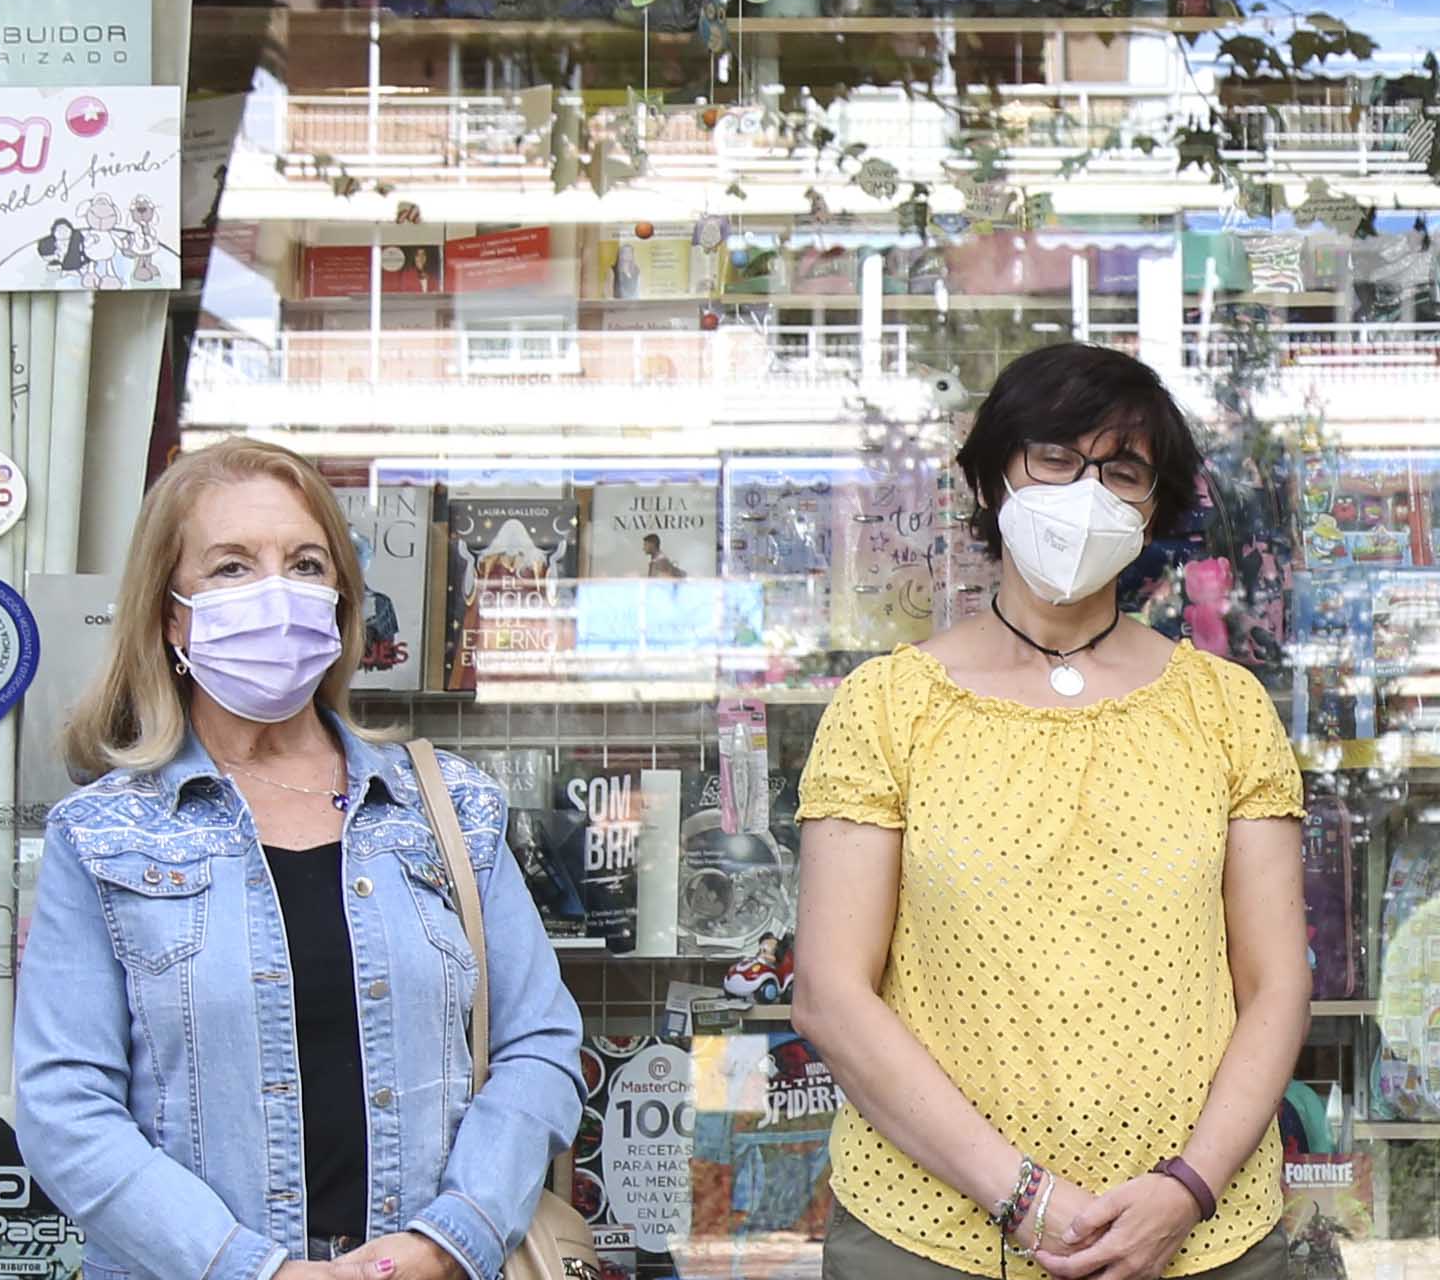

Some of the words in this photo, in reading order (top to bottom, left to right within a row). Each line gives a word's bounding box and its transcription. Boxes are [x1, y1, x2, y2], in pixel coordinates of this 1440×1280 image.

[628, 495, 690, 513] JULIA
[477, 506, 506, 517] LAURA
[507, 506, 550, 517] GALLEGO
[612, 513, 705, 532] NAVARRO
[479, 591, 543, 609] CICLO
[567, 772, 632, 821] SOM
[627, 1144, 696, 1157] RECETAS
[613, 1160, 653, 1172] PARA
[1284, 1161, 1354, 1185] FORTNITE
[622, 1176, 641, 1188] AL
[627, 1191, 658, 1204] UNA
[637, 1207, 658, 1219] EN
[661, 1207, 681, 1219] LA
[642, 1222, 677, 1235] VIDA
[603, 1234, 631, 1246] CAR
